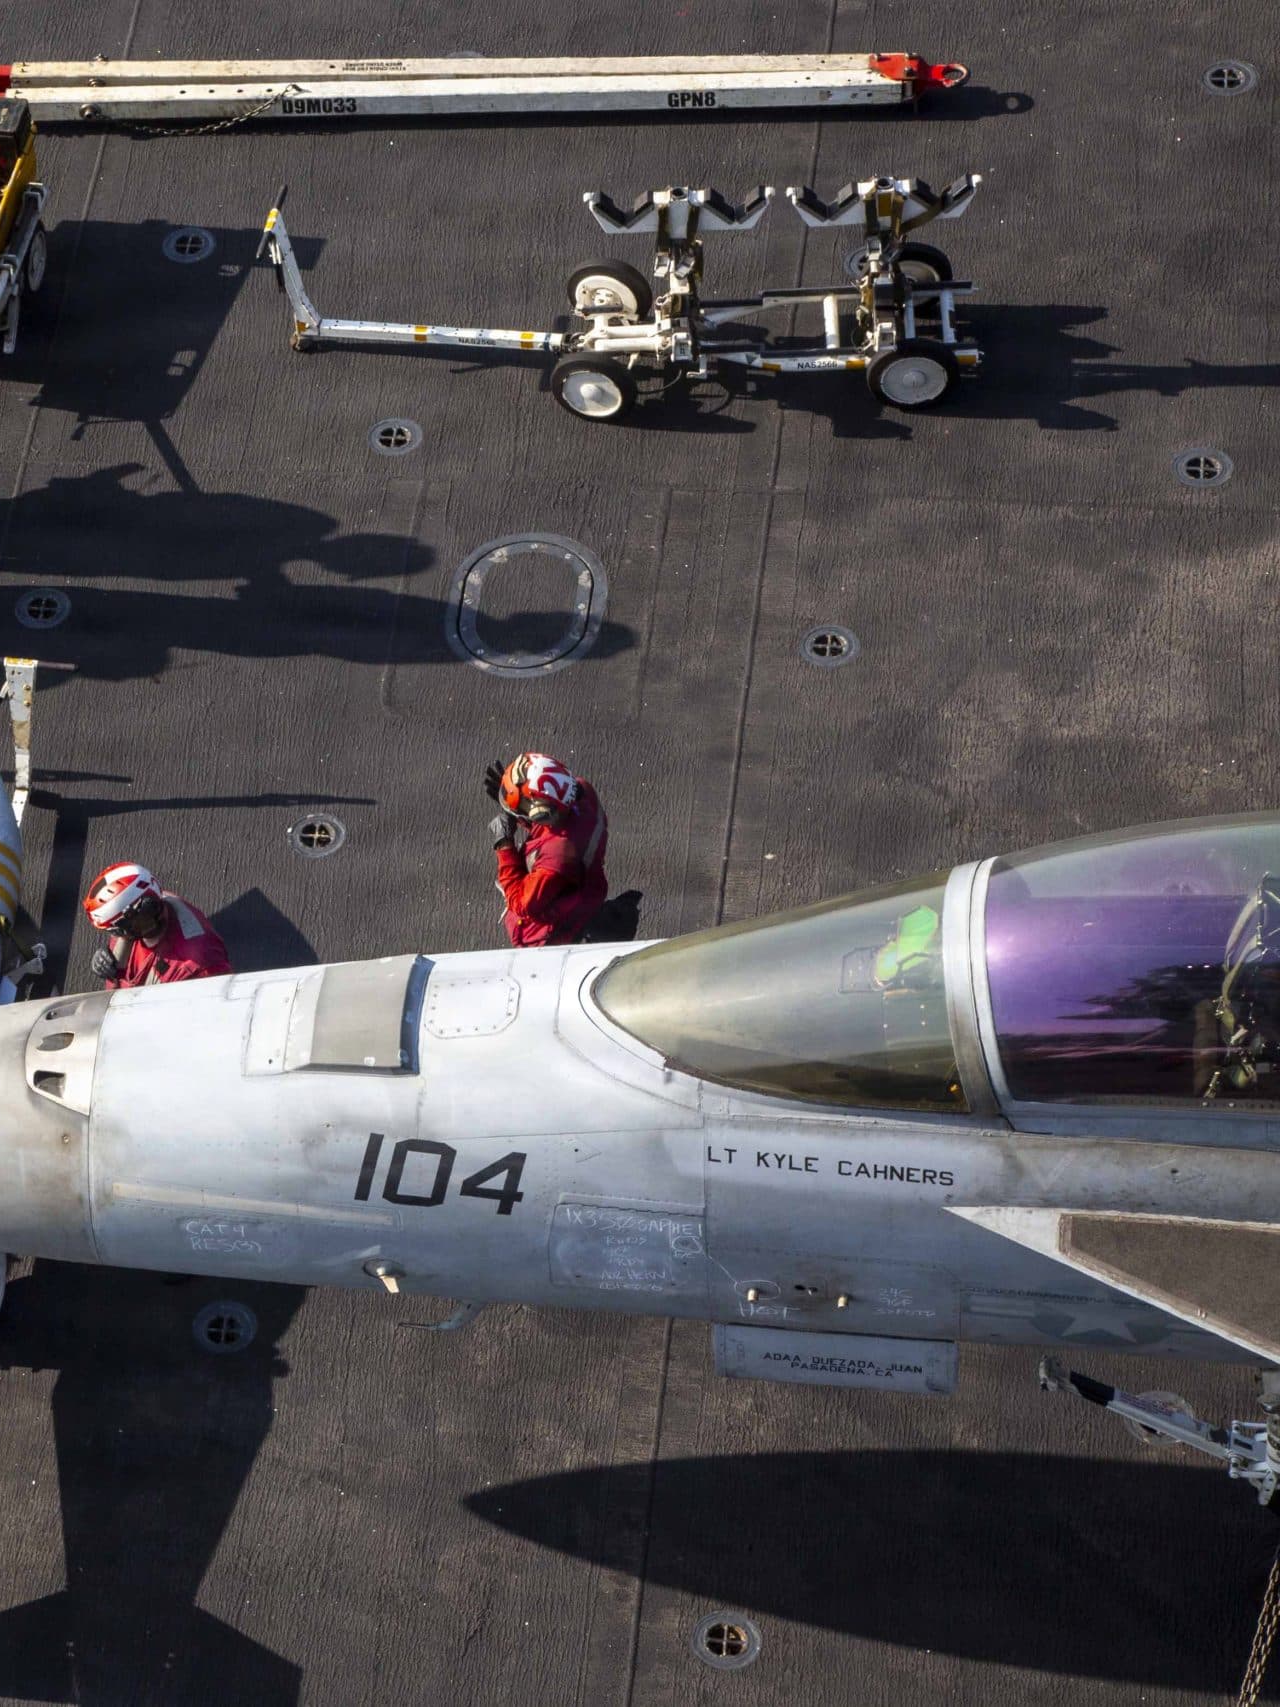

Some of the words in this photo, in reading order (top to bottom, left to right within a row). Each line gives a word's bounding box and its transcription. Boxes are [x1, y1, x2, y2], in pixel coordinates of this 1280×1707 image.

[667, 91, 716, 107] GPN8
[354, 1133, 527, 1216] 104
[707, 1145, 737, 1164] LT
[756, 1150, 820, 1174] KYLE
[837, 1160, 955, 1187] CAHNERS
[886, 1362, 924, 1375] JUAN
